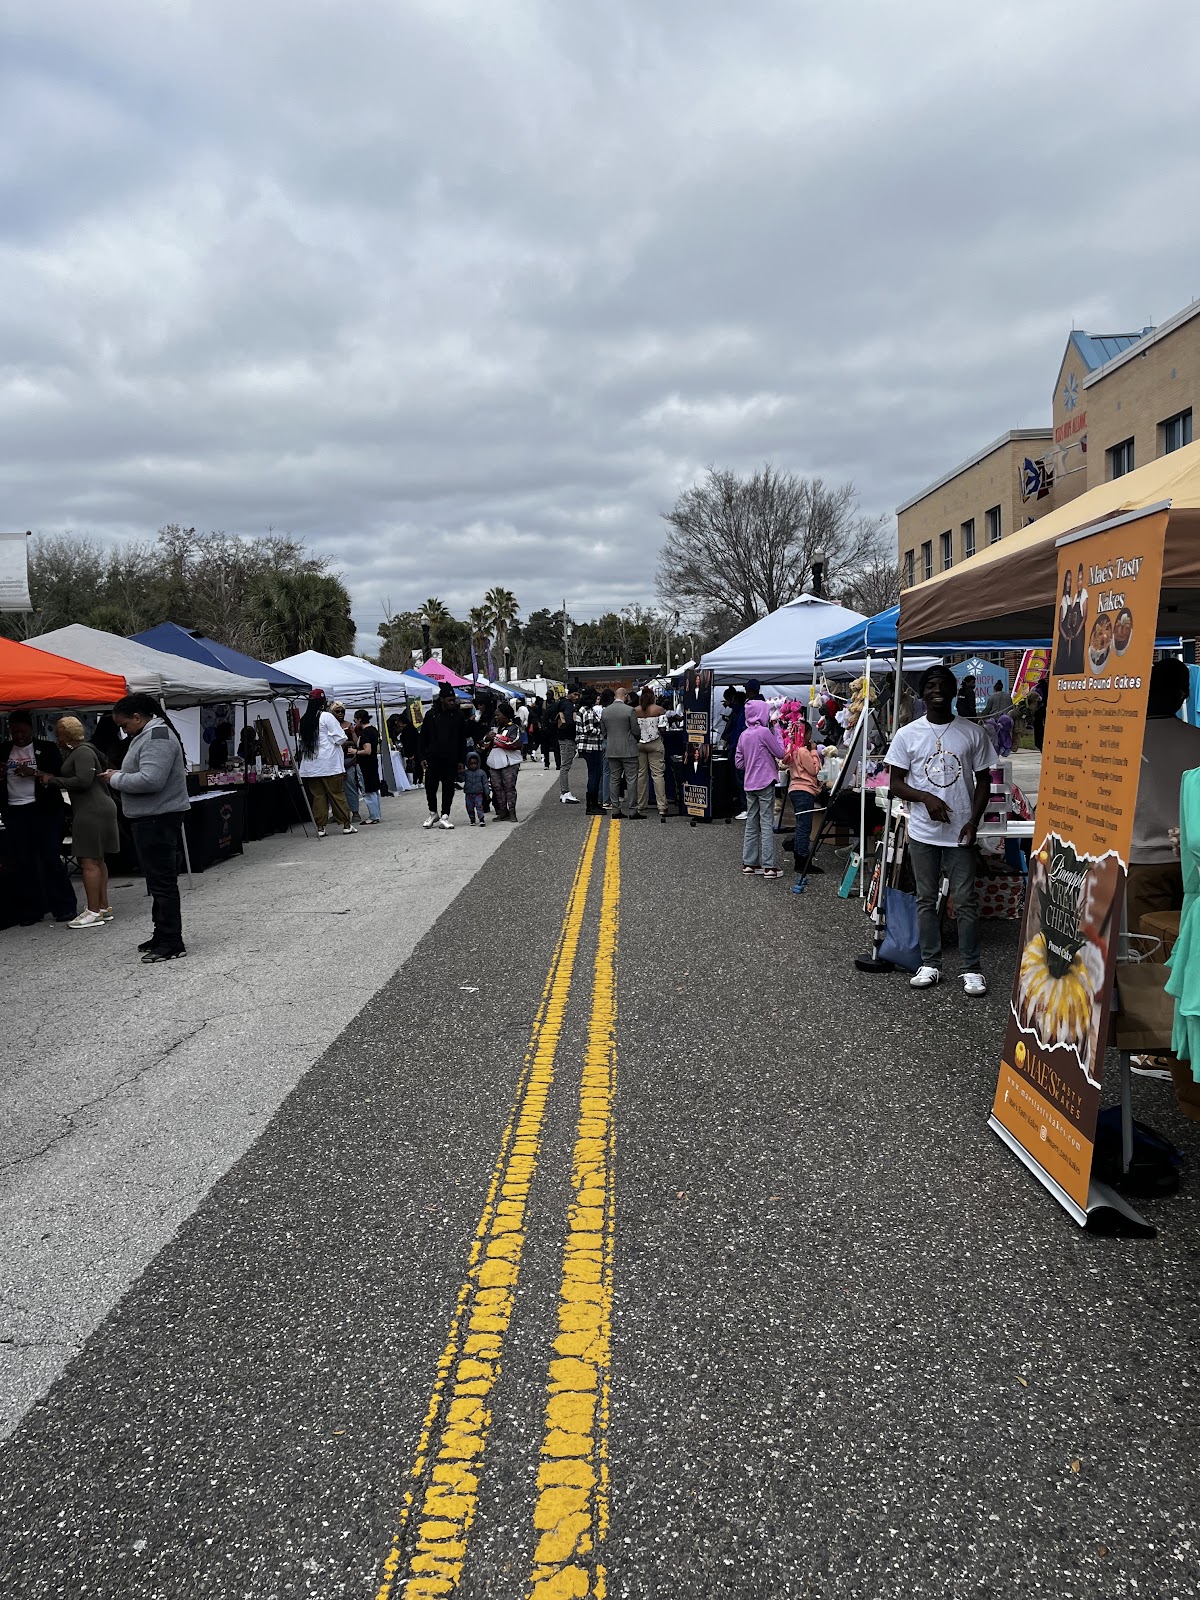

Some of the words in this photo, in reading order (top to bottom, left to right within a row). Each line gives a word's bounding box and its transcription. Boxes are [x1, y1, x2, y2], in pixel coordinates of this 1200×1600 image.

[1073, 410, 1087, 434] ALLIANC
[1088, 560, 1113, 586] Mae's
[1116, 556, 1143, 581] Tasty
[1097, 589, 1125, 613] Kakes
[1057, 676, 1087, 691] Flavored
[1088, 674, 1112, 689] Pound
[1114, 674, 1142, 689] Cakes
[1045, 905, 1081, 943] CHEESE
[1047, 940, 1062, 955] Pound
[1060, 947, 1073, 962] Cake
[1023, 1048, 1057, 1097] MAE'S
[1057, 1076, 1083, 1106] TASTY
[1055, 1089, 1081, 1120] KAKES
